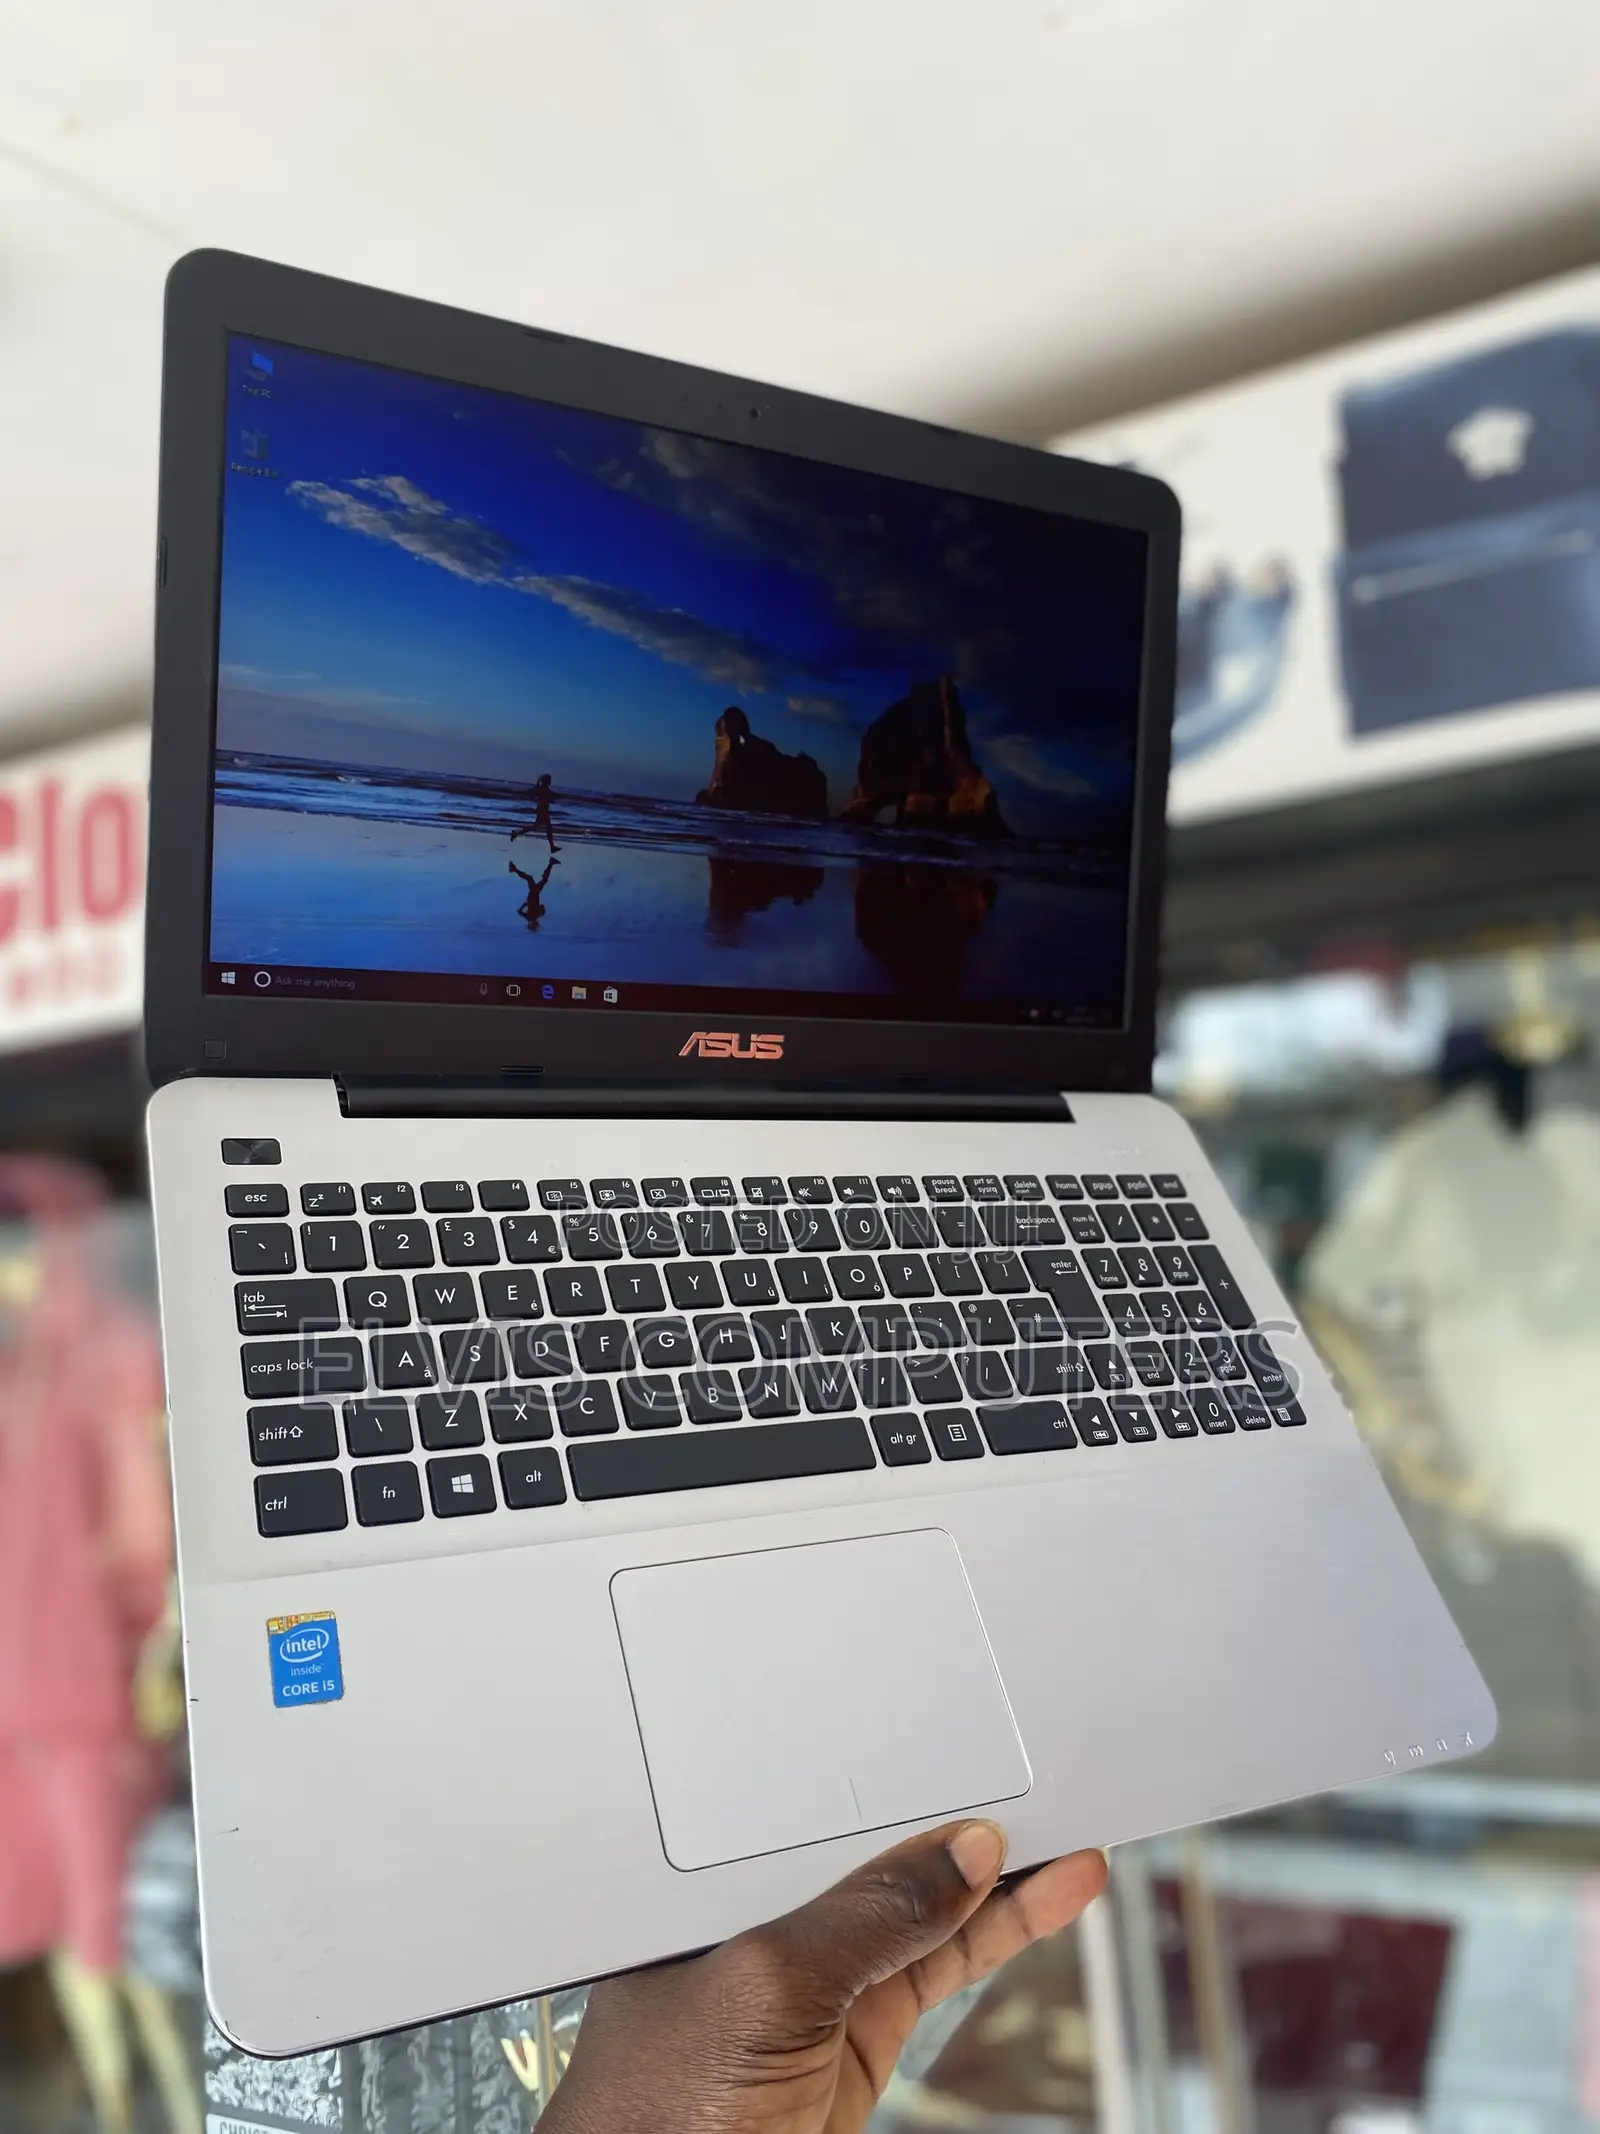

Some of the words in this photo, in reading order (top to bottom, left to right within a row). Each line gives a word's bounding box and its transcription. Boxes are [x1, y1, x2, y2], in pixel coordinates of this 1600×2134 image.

[275, 976, 293, 987] Ask
[295, 978, 311, 987] me
[313, 978, 355, 991] anything
[678, 1031, 785, 1059] ASUS
[397, 1185, 406, 1193] f2
[455, 1184, 465, 1192] f3
[569, 1181, 578, 1189] f5
[813, 1178, 825, 1186] f10
[974, 1178, 985, 1186] prt
[1014, 1181, 1037, 1189] delete
[1055, 1181, 1078, 1189] home
[1092, 1182, 1113, 1191] pgup
[1127, 1181, 1148, 1190] pgdn
[244, 1193, 267, 1202] esc
[508, 1219, 515, 1230] $
[569, 1218, 580, 1227] %
[685, 1214, 694, 1223] &
[1015, 1215, 1055, 1225] backspace
[444, 1221, 452, 1231] £
[646, 1225, 658, 1240] 6
[701, 1224, 711, 1238] 7
[757, 1222, 767, 1236] 8
[808, 1221, 819, 1234] 9
[859, 1220, 870, 1234] 0
[1089, 1229, 1097, 1237] lk
[397, 1234, 409, 1249] 2
[464, 1232, 475, 1247] 3
[527, 1229, 539, 1244] 4
[588, 1227, 599, 1242] 5
[329, 1235, 336, 1252] 1
[1051, 1261, 1072, 1269] enter
[1100, 1260, 1108, 1273] 7
[1138, 1258, 1149, 1272] 8
[1172, 1256, 1182, 1270] 9
[744, 1272, 757, 1287] U
[850, 1268, 866, 1283] O
[903, 1267, 913, 1280] P
[1100, 1274, 1119, 1282] home
[571, 1282, 584, 1297] R
[630, 1278, 641, 1294] T
[687, 1275, 699, 1291] Y
[243, 1292, 265, 1304] tab
[368, 1290, 388, 1309] Q
[434, 1287, 456, 1304] W
[507, 1285, 518, 1300] E
[968, 1303, 978, 1313] @
[1126, 1305, 1135, 1319] 4
[1161, 1303, 1172, 1318] 5
[1197, 1302, 1207, 1316] 6
[1033, 1313, 1042, 1323] #
[779, 1324, 787, 1341] J
[830, 1321, 844, 1337] K
[885, 1319, 896, 1333] L
[658, 1331, 675, 1348] G
[719, 1327, 733, 1344] H
[535, 1340, 549, 1357] D
[600, 1336, 610, 1353] F
[398, 1350, 415, 1368] A
[469, 1345, 481, 1363] S
[1184, 1352, 1196, 1366] 2
[1220, 1350, 1231, 1363] 3
[250, 1359, 283, 1374] caps
[286, 1358, 314, 1371] lock
[1055, 1363, 1075, 1374] shift
[1147, 1354, 1156, 1369] 1
[1147, 1371, 1160, 1380] end
[1220, 1364, 1236, 1374] pgdn
[1262, 1374, 1283, 1383] enter
[764, 1381, 779, 1398] N
[821, 1378, 839, 1394] M
[643, 1391, 657, 1408] V
[707, 1387, 719, 1403] B
[514, 1403, 528, 1421] X
[580, 1397, 595, 1415] C
[1209, 1402, 1219, 1417] 0
[445, 1409, 459, 1427] Z
[1053, 1418, 1067, 1429] ctrl
[1208, 1419, 1228, 1428] insert
[1245, 1415, 1266, 1424] delete
[258, 1427, 288, 1441] shift
[890, 1432, 904, 1444] alt
[906, 1433, 917, 1445] gr
[525, 1469, 542, 1483] alt
[381, 1485, 396, 1499] fn
[264, 1496, 288, 1511] ctrl
[286, 1634, 321, 1654] intel
[290, 1664, 322, 1677] inside
[282, 1681, 319, 1697] CORE
[322, 1680, 335, 1691] i5
